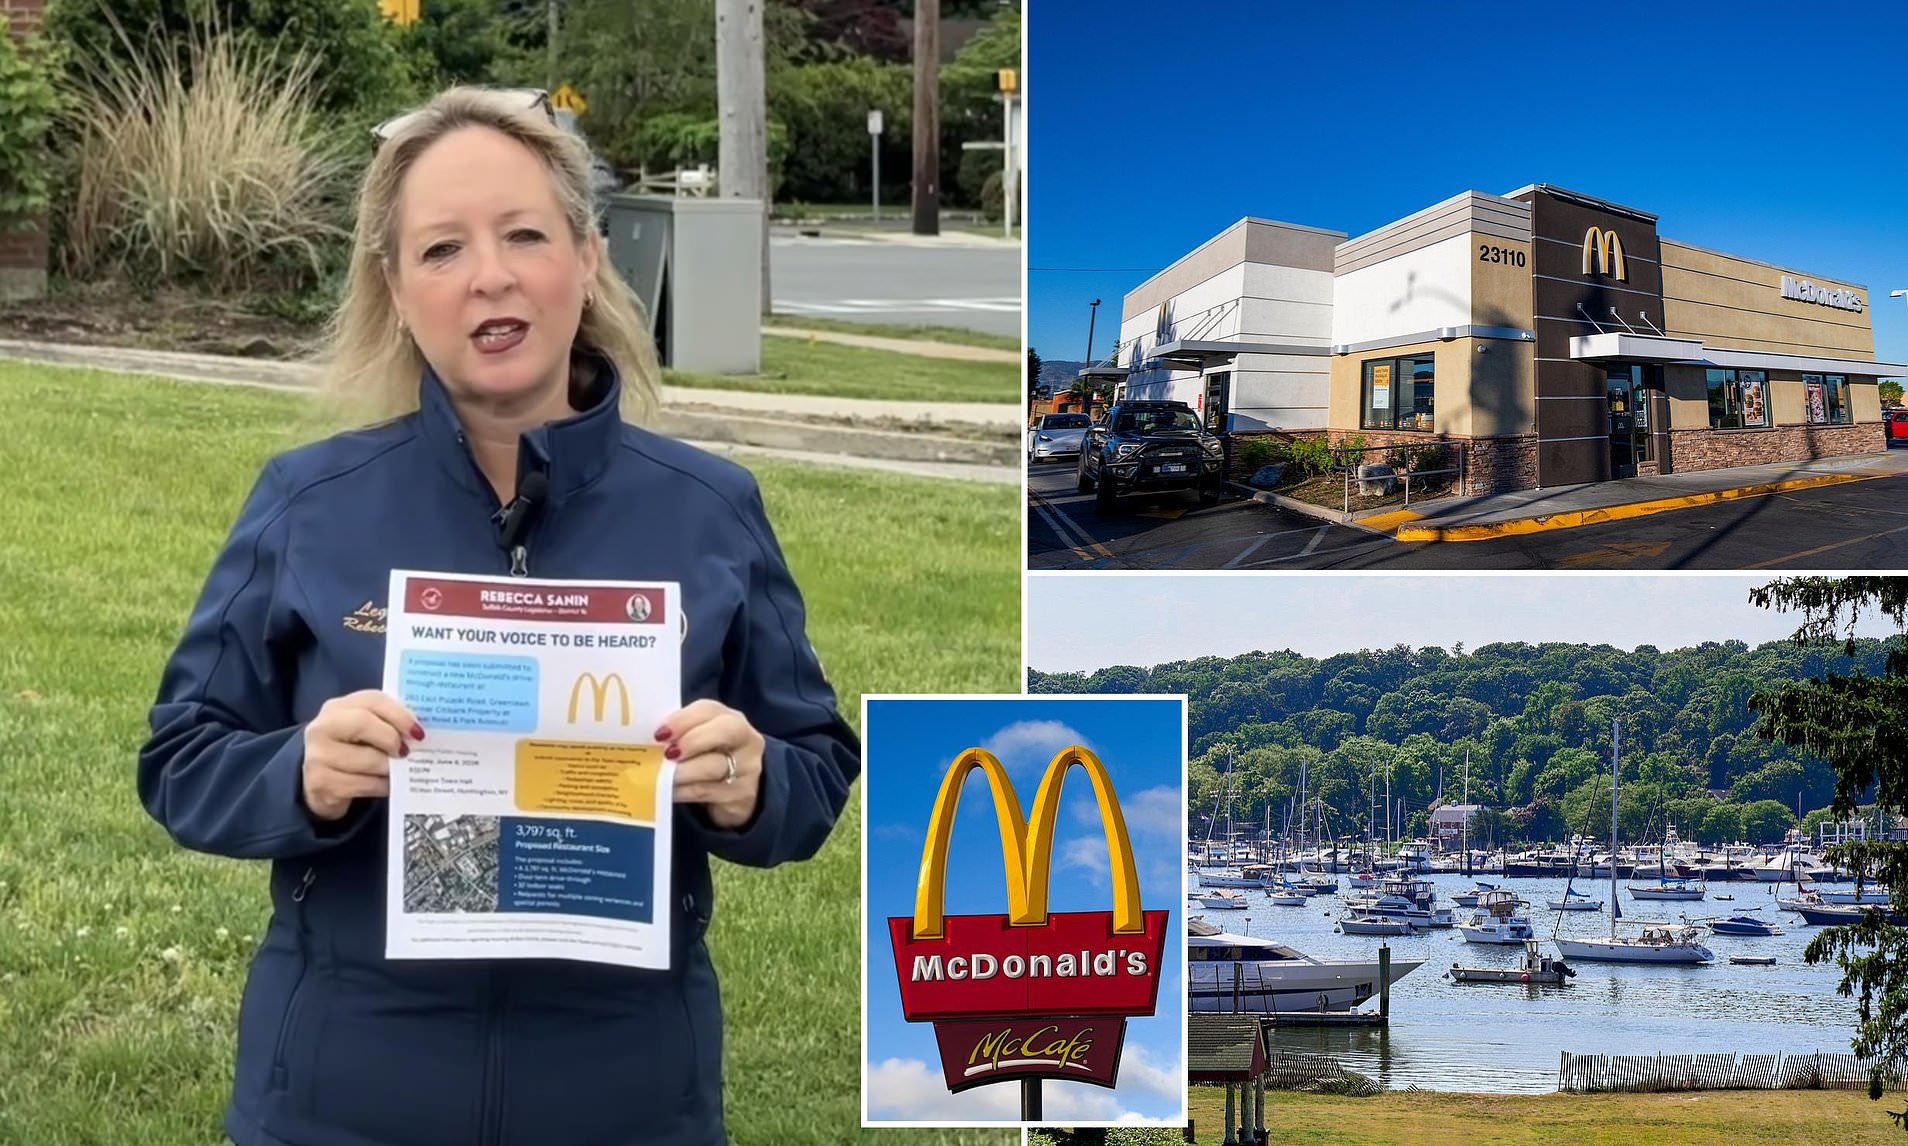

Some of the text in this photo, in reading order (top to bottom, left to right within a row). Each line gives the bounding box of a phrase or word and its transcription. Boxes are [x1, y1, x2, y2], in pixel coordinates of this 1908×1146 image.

[1479, 245, 1526, 268] 23110
[1781, 275, 1862, 313] McDonald's
[481, 590, 589, 606] REBECCA SANIN
[354, 600, 386, 621] Leg
[343, 616, 386, 633] Rebec
[412, 625, 657, 648] WANT YOUR VOICE TO BE HEARD?
[515, 824, 546, 839] 3,797
[565, 826, 578, 839] ft.
[515, 840, 611, 854] Proposed Restaurant Size
[911, 950, 1148, 982] McDonald's
[968, 1025, 1094, 1071] McCafé
